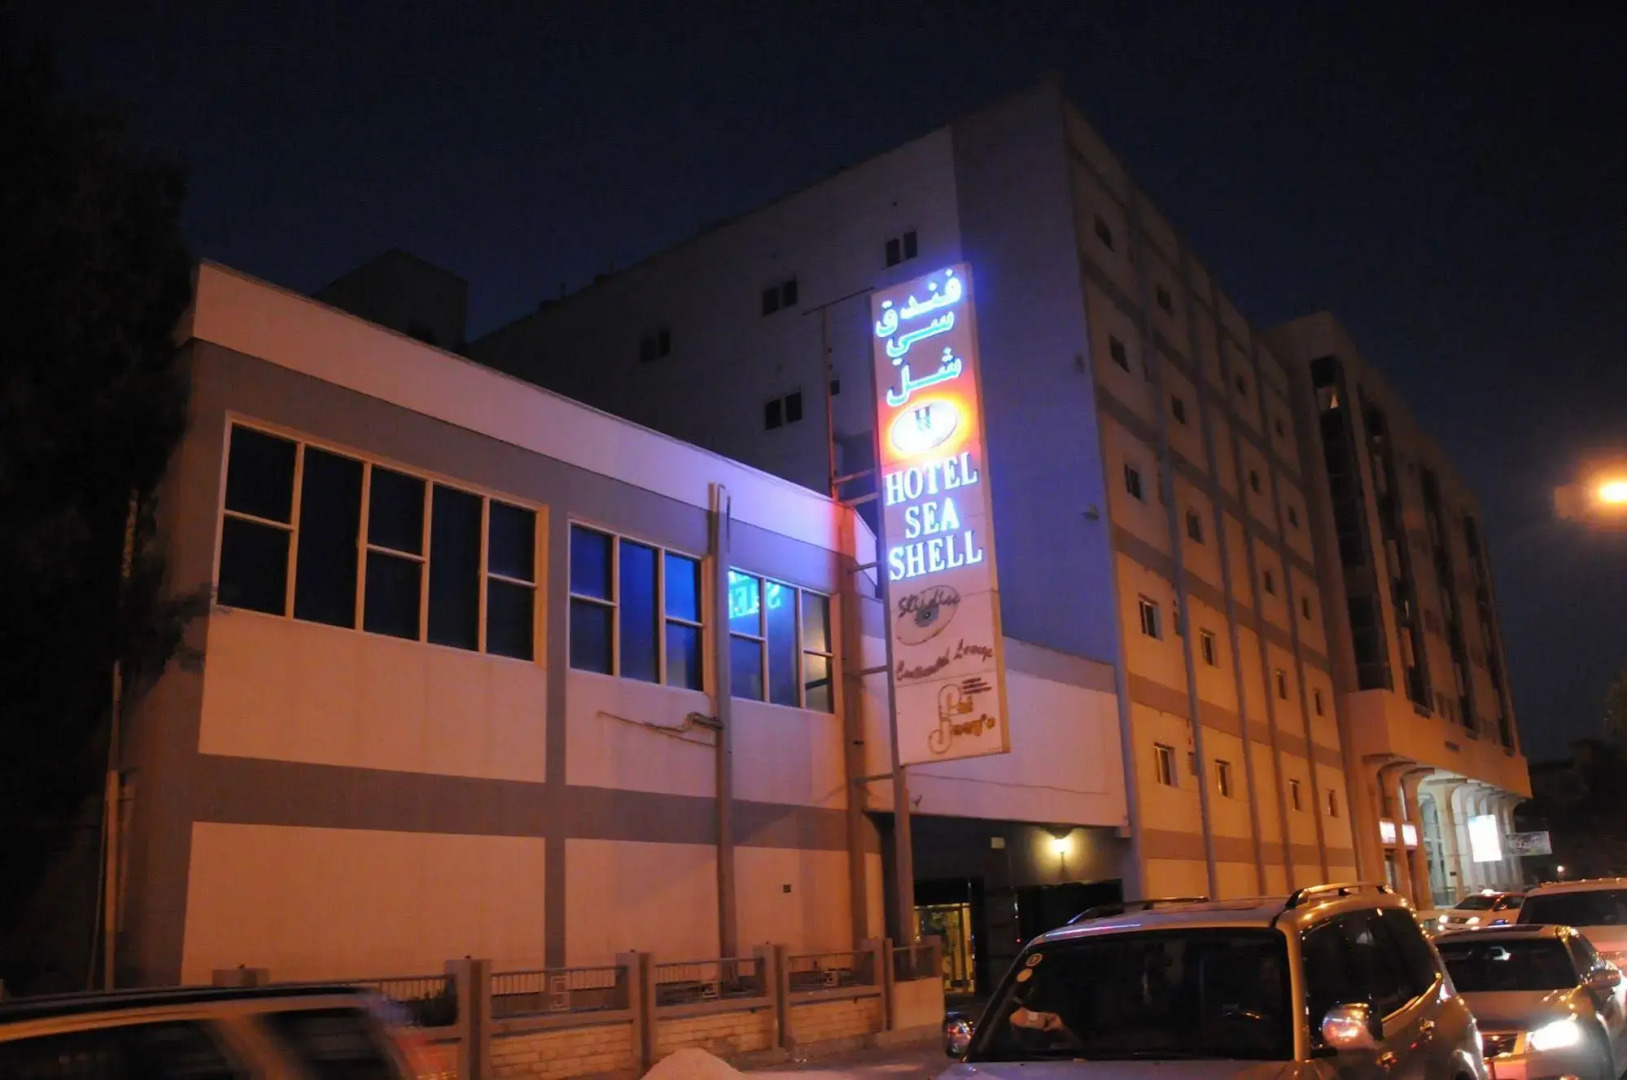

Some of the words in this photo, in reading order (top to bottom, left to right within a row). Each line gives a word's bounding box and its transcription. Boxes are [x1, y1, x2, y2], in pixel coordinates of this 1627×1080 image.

[876, 268, 962, 338] فندق
[886, 311, 955, 366] سي
[886, 347, 962, 407] شل
[884, 452, 978, 506] HOTEL
[905, 497, 960, 539] SEA
[888, 530, 983, 581] SHELL
